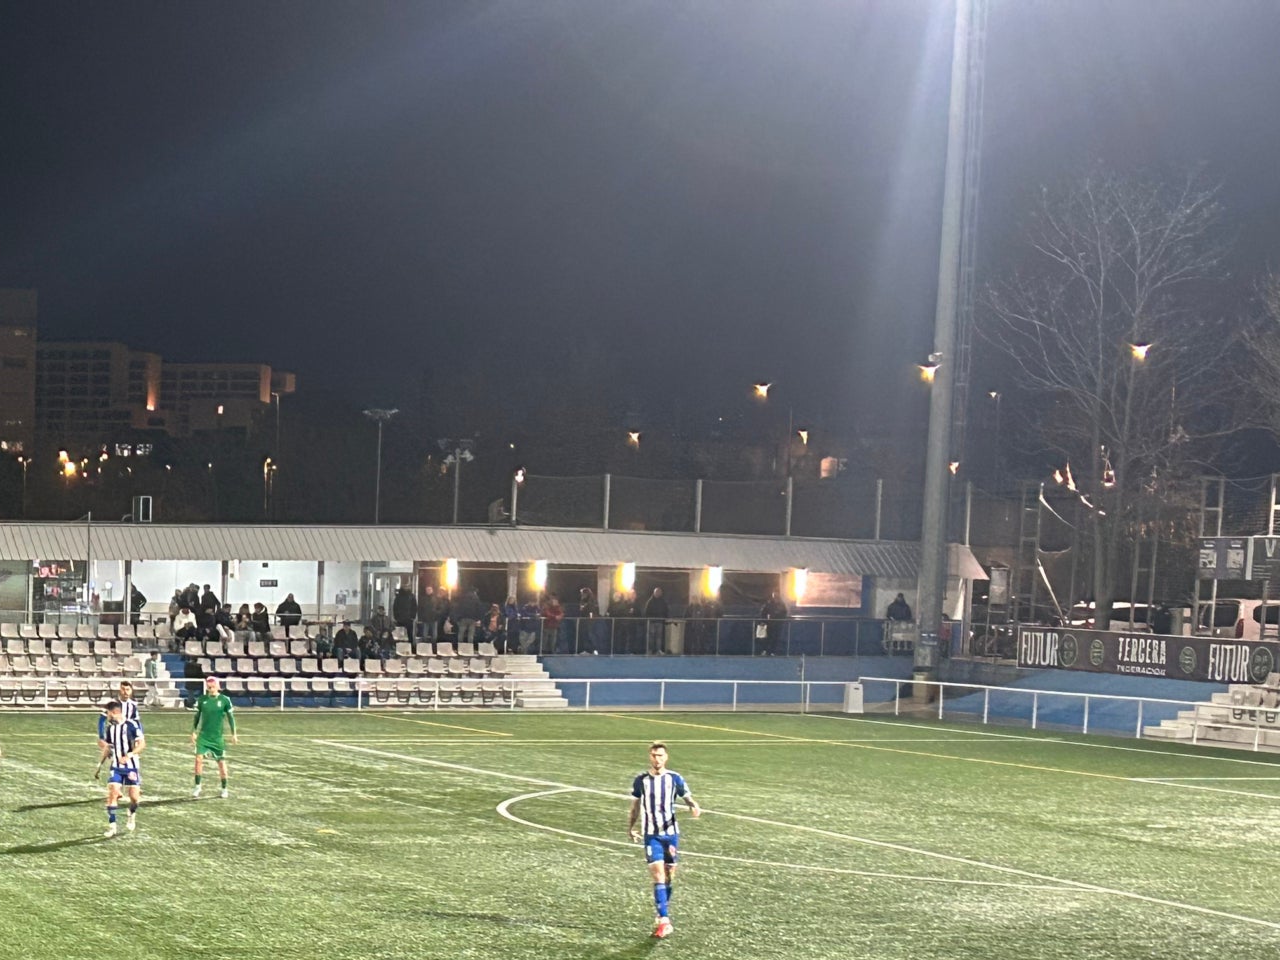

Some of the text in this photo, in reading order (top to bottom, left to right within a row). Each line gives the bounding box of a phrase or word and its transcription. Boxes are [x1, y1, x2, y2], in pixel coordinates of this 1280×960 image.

[1021, 631, 1058, 667] FUTUR
[1118, 637, 1166, 664] TERCERA
[1208, 643, 1250, 682] FUTUR
